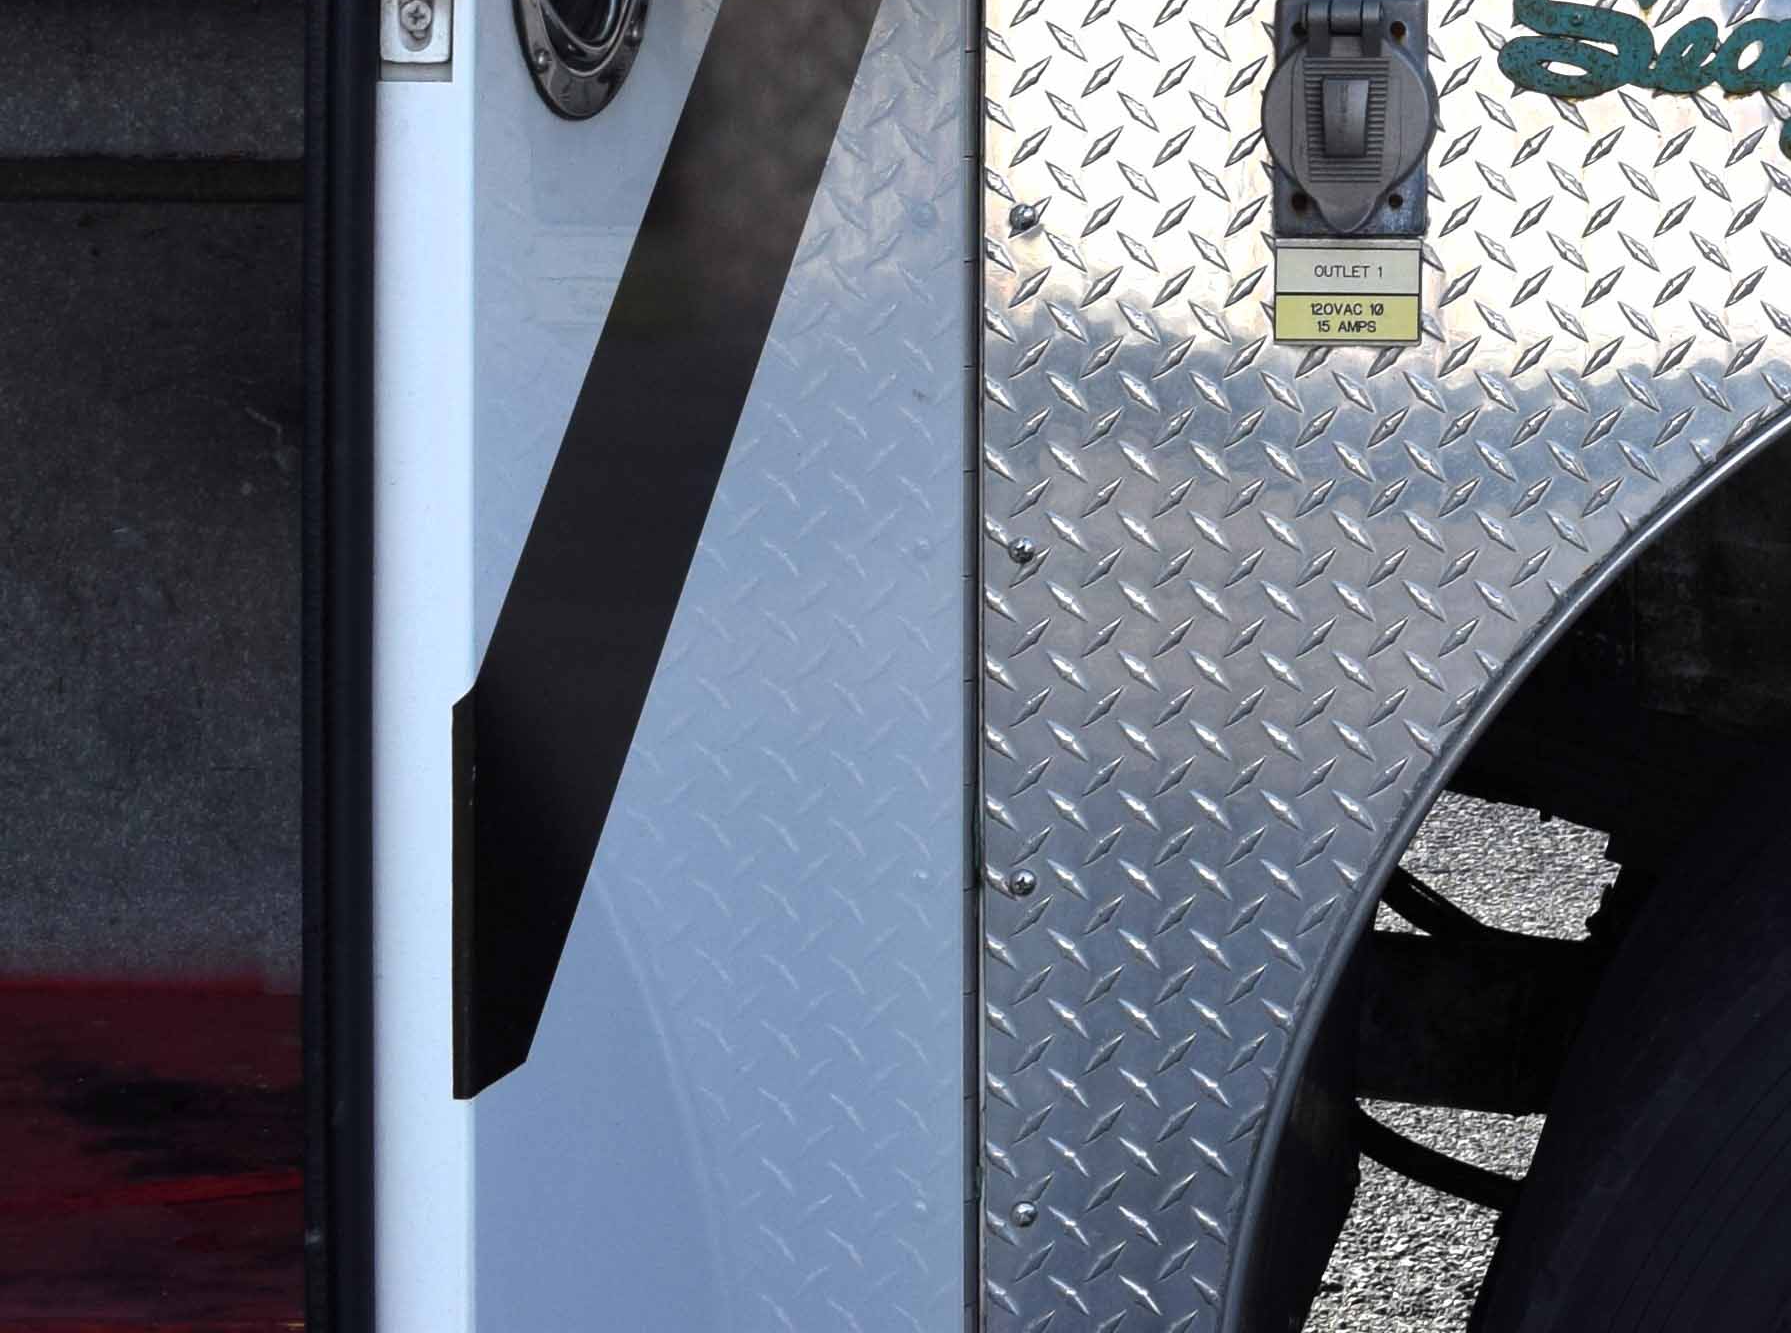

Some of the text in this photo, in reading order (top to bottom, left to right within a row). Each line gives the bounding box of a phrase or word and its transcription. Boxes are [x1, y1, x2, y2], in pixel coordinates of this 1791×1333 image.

[1314, 265, 1383, 277] OUTLET 1
[1311, 303, 1363, 316] 120VAC
[1317, 320, 1377, 333] 15 AMPS
